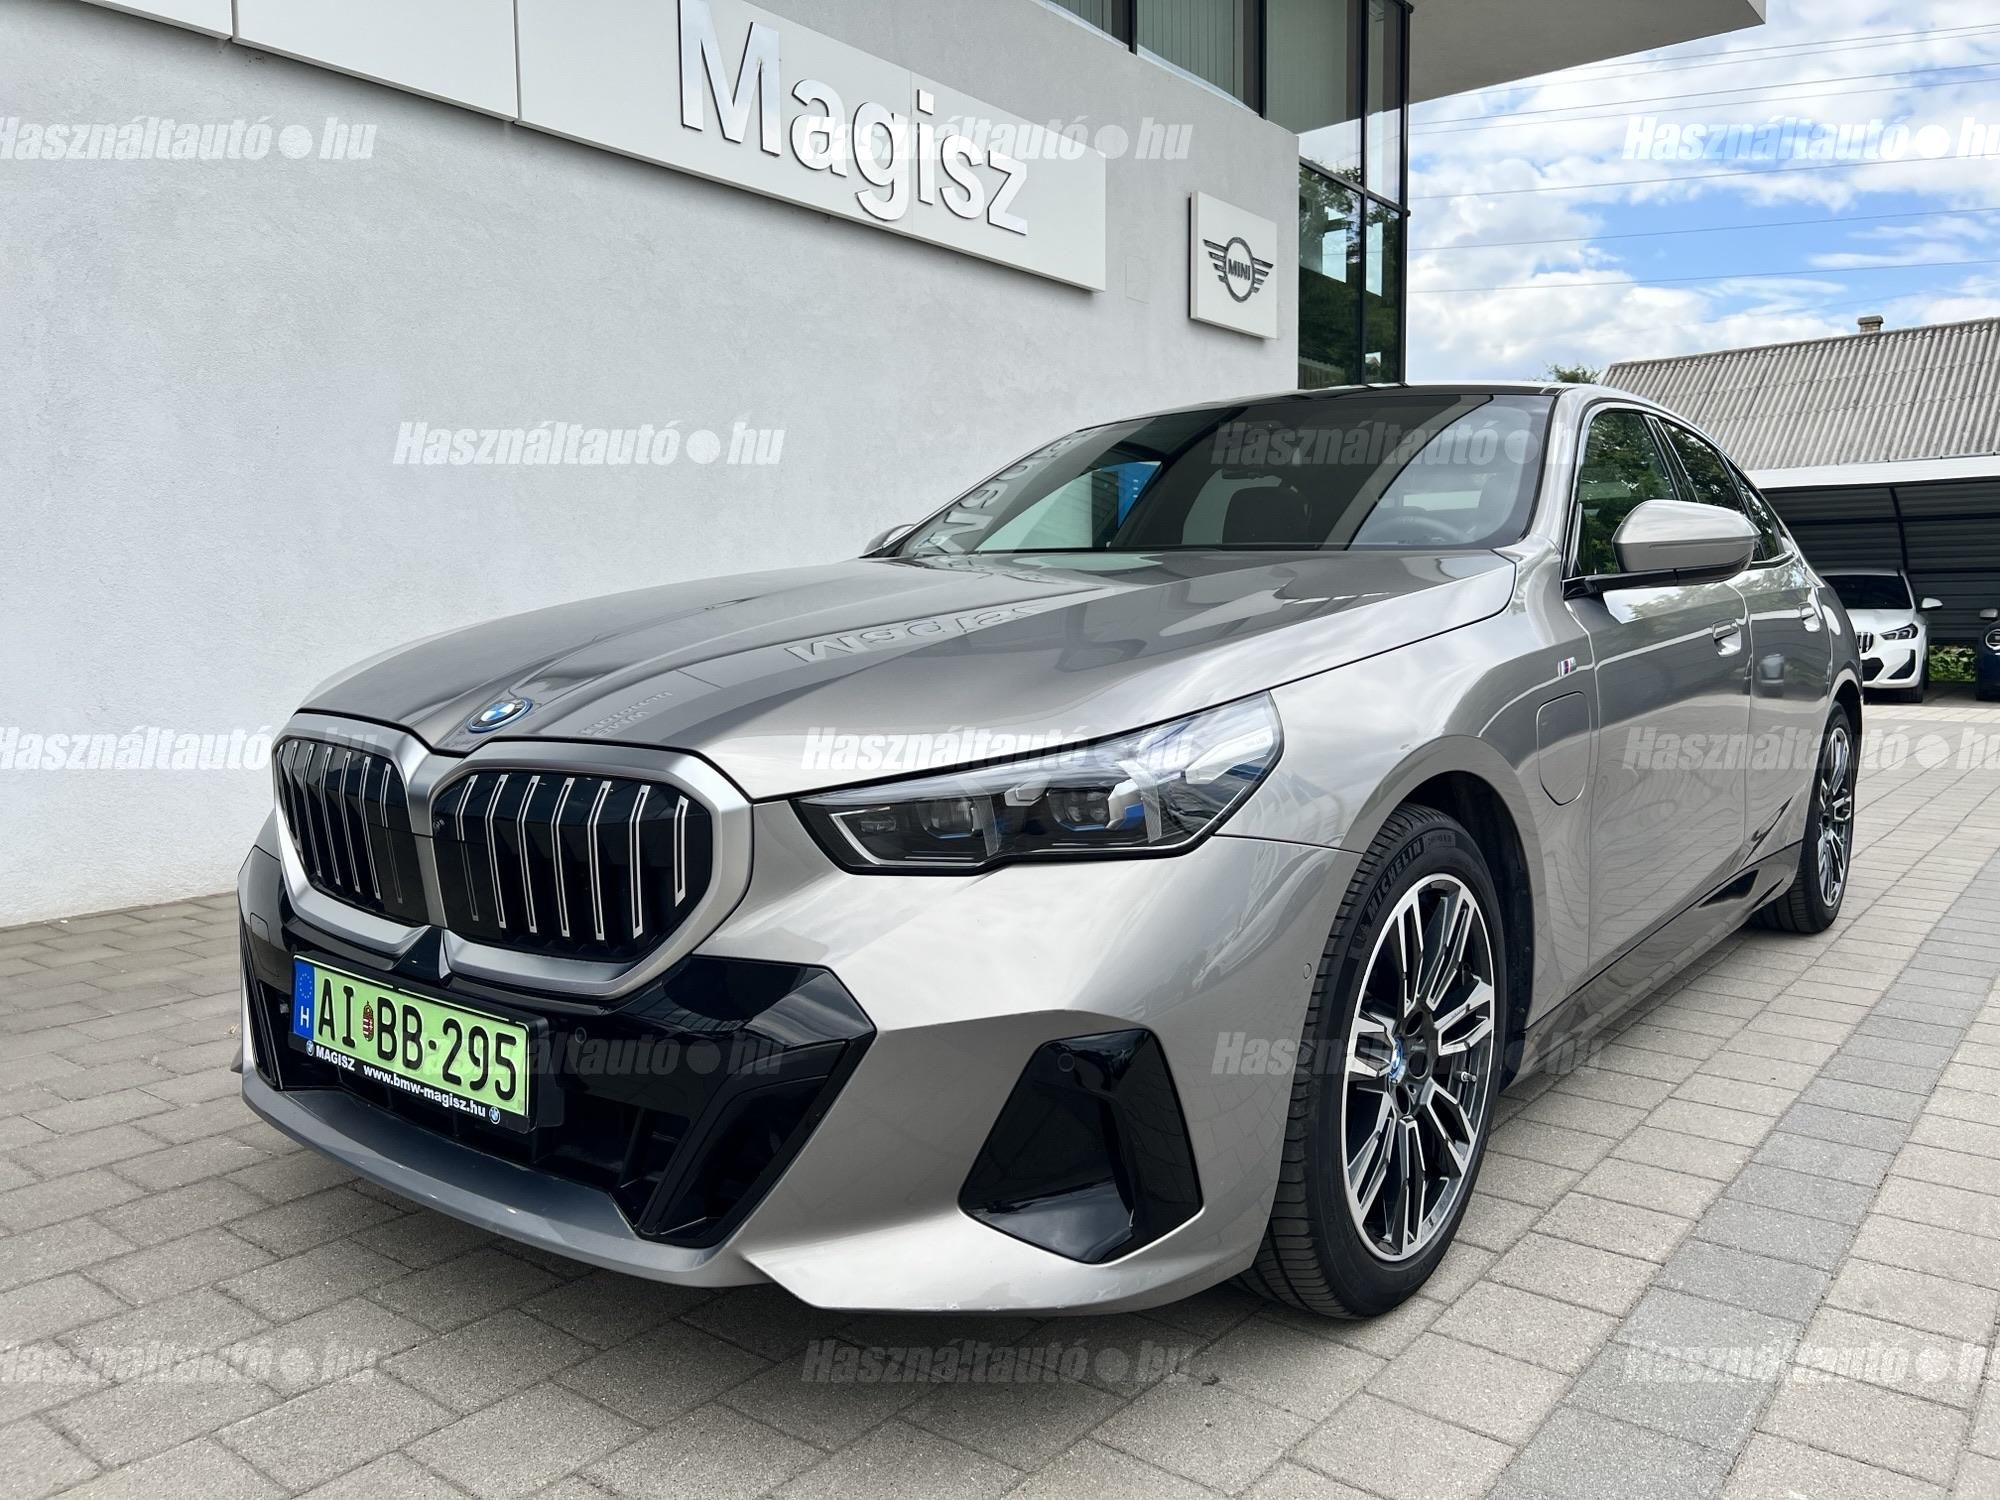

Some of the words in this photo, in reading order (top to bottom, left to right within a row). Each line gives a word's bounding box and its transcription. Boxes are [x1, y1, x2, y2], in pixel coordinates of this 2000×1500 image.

[677, 0, 1028, 236] Magisz
[1228, 258, 1251, 281] MINI
[1368, 837, 1425, 923] MICHELIN
[299, 1005, 310, 1029] H
[318, 977, 356, 1049] AI
[315, 1045, 356, 1072] MAGISZ
[363, 1063, 487, 1118] www.bmw-magisz.hu
